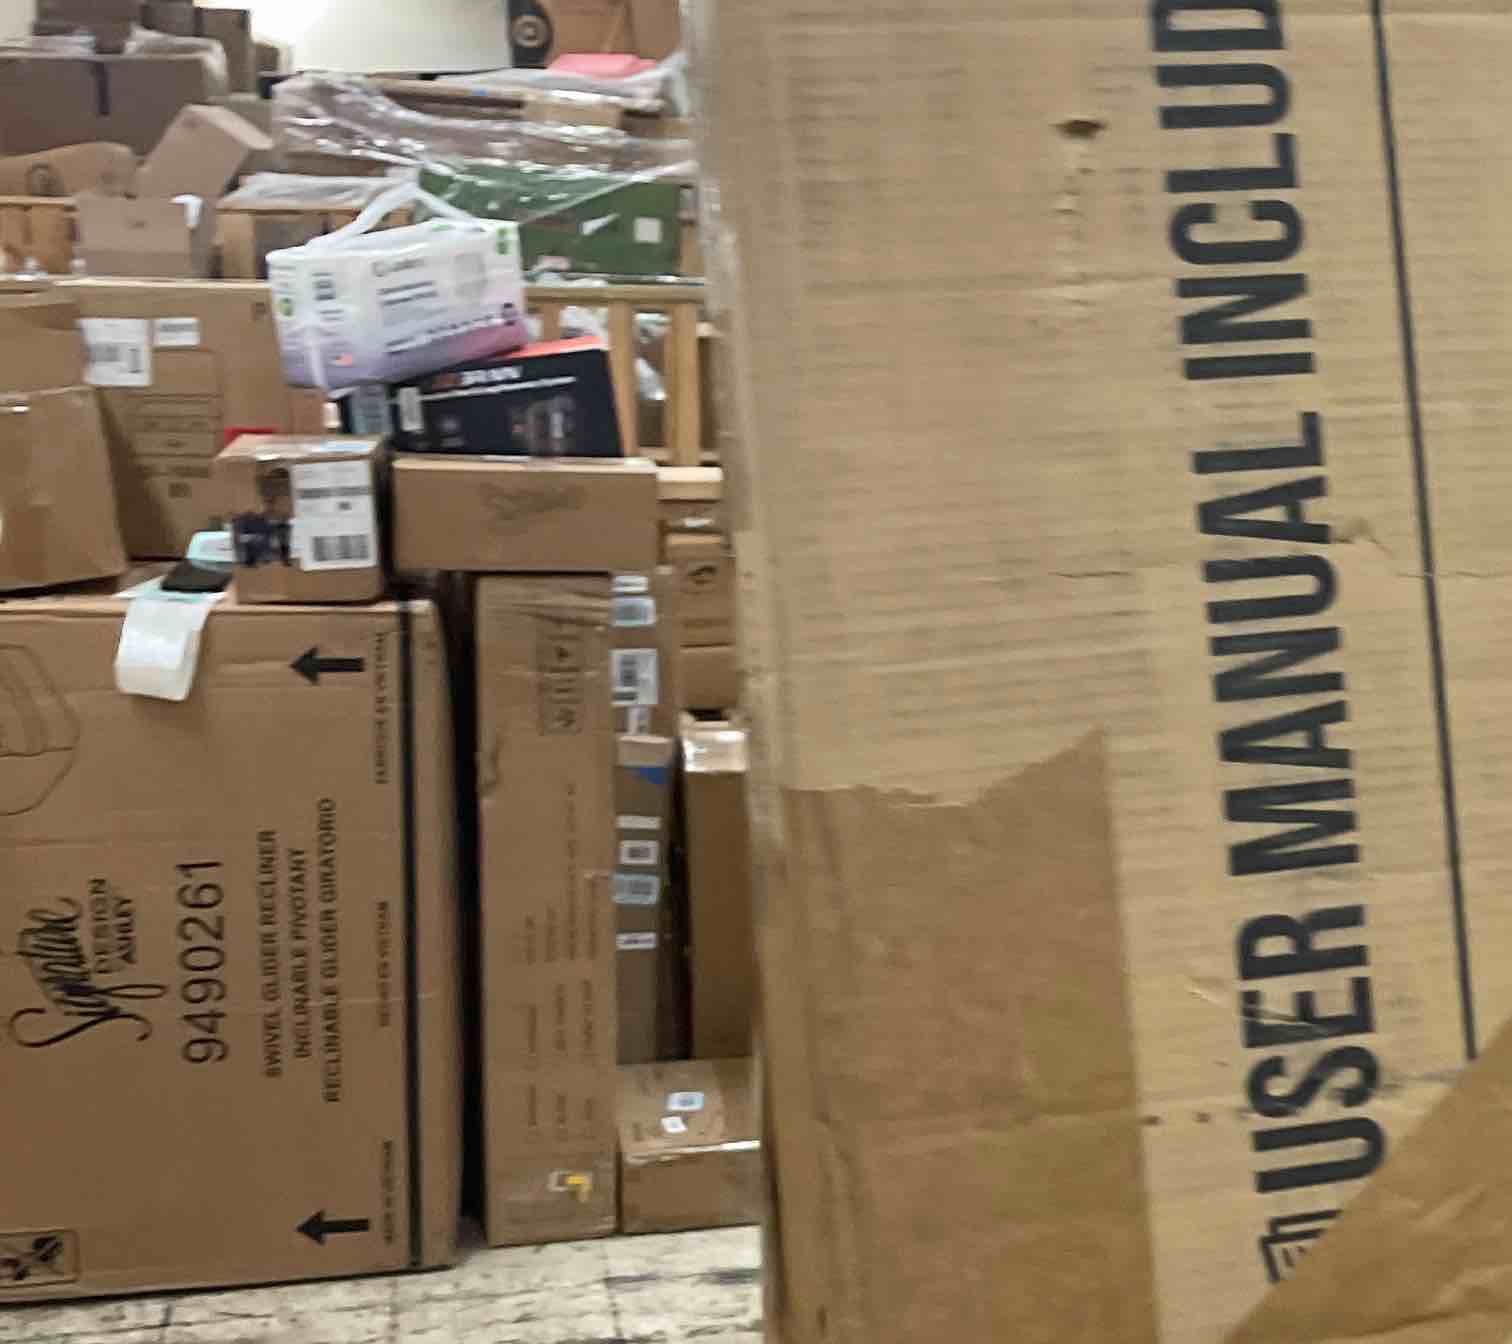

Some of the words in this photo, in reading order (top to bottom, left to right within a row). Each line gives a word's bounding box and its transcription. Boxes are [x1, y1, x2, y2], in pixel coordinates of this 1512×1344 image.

[1192, 410, 1361, 877] MANUAL
[258, 829, 278, 926] RECLINER
[287, 846, 310, 942] PIVOTANT
[316, 798, 338, 905] GIRATORIO
[8, 896, 167, 1048] Signature
[113, 895, 136, 964] ASHLEY
[175, 860, 228, 1064] 9490261
[260, 929, 281, 1002] GLIDER
[319, 908, 340, 980] GLIDER
[261, 1009, 282, 1078] SWIVEL
[290, 947, 312, 1059] INCLINABLE
[320, 984, 342, 1104] RECLINABLE
[1236, 903, 1387, 1194] USER
